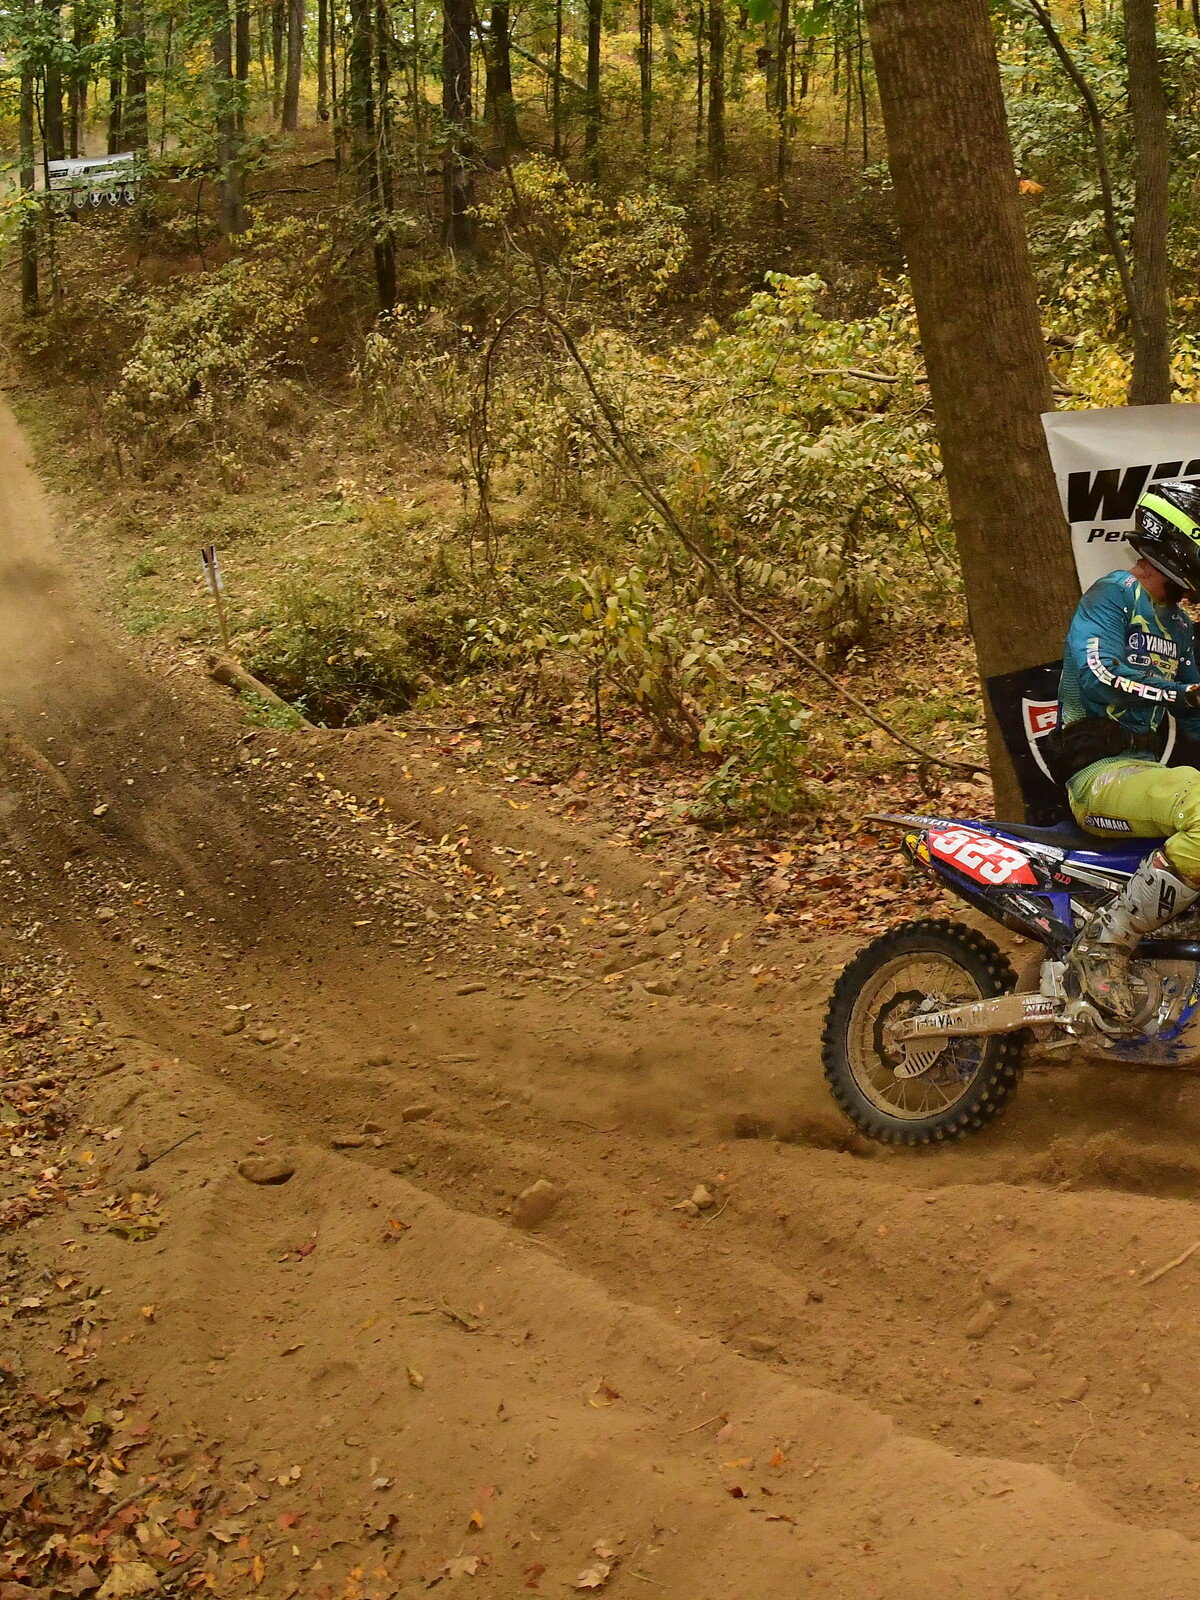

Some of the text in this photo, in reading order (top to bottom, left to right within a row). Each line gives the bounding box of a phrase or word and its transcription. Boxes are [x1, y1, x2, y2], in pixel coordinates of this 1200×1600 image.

[1142, 515, 1162, 537] 523
[1146, 634, 1178, 659] YAMAHA
[1093, 816, 1131, 832] YAMAHA
[932, 829, 1028, 884] 523
